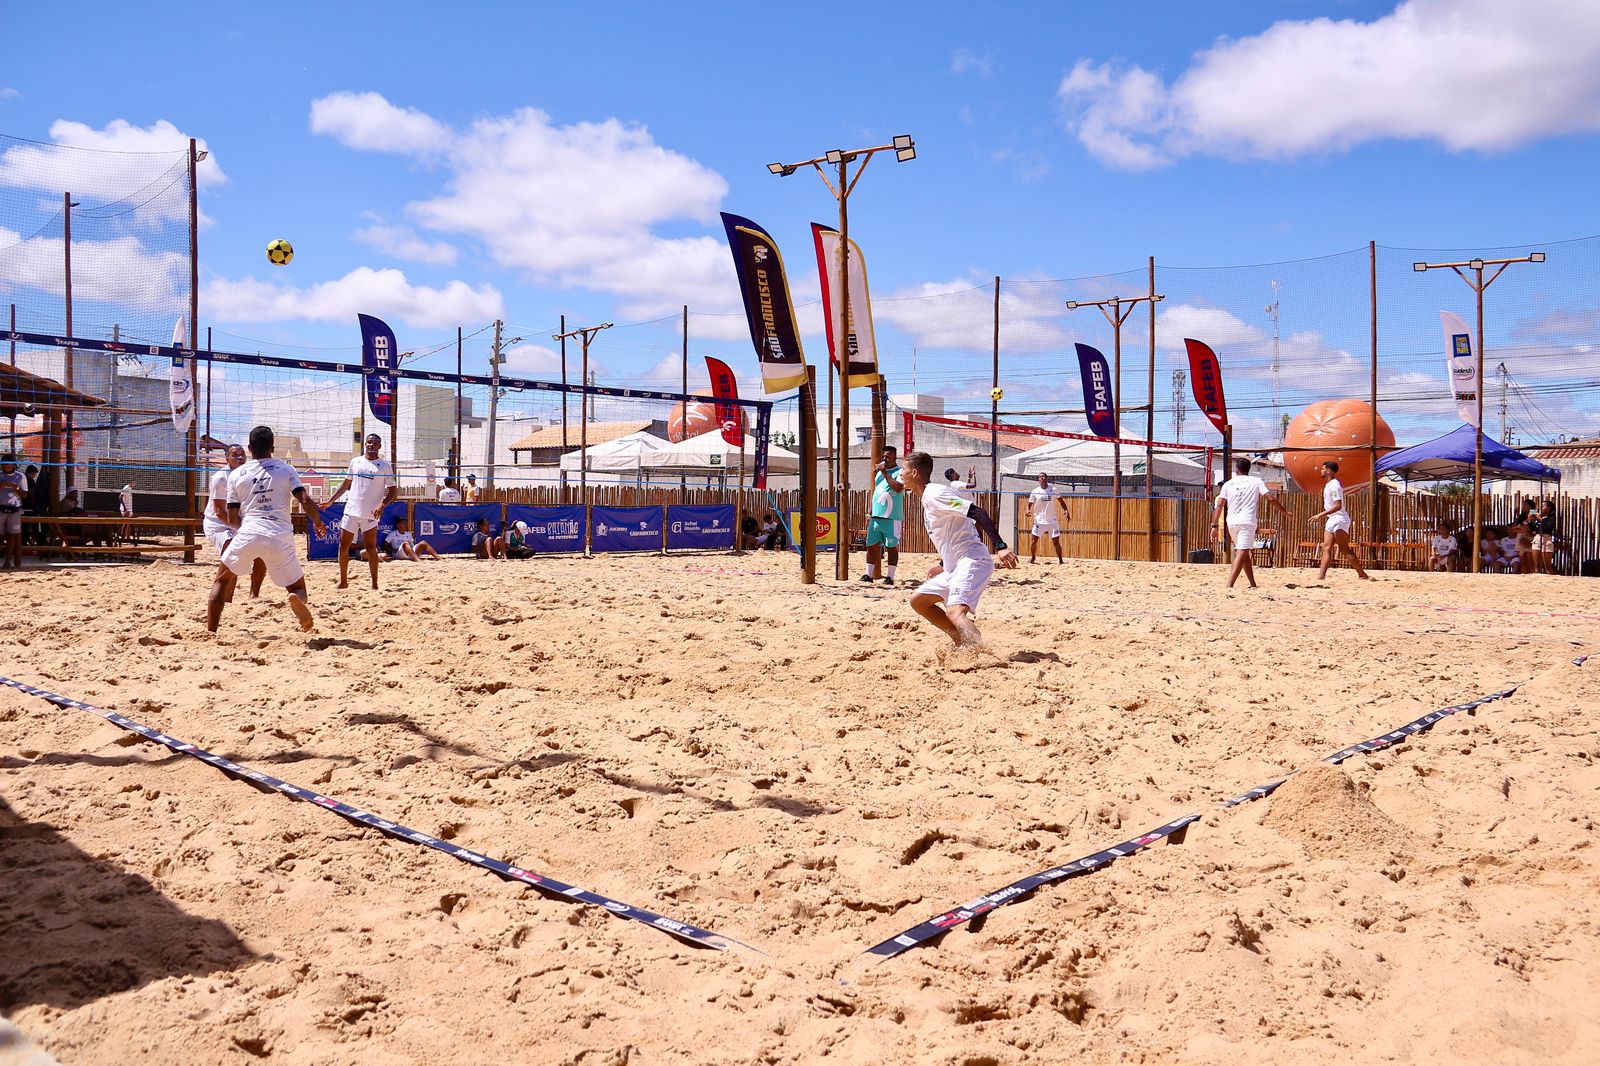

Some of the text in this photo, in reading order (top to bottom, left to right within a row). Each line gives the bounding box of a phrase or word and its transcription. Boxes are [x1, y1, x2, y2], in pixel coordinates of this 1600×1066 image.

[1090, 361, 1108, 411] FAFEB
[1201, 359, 1218, 412] FAFEB
[527, 526, 546, 534] AFEB
